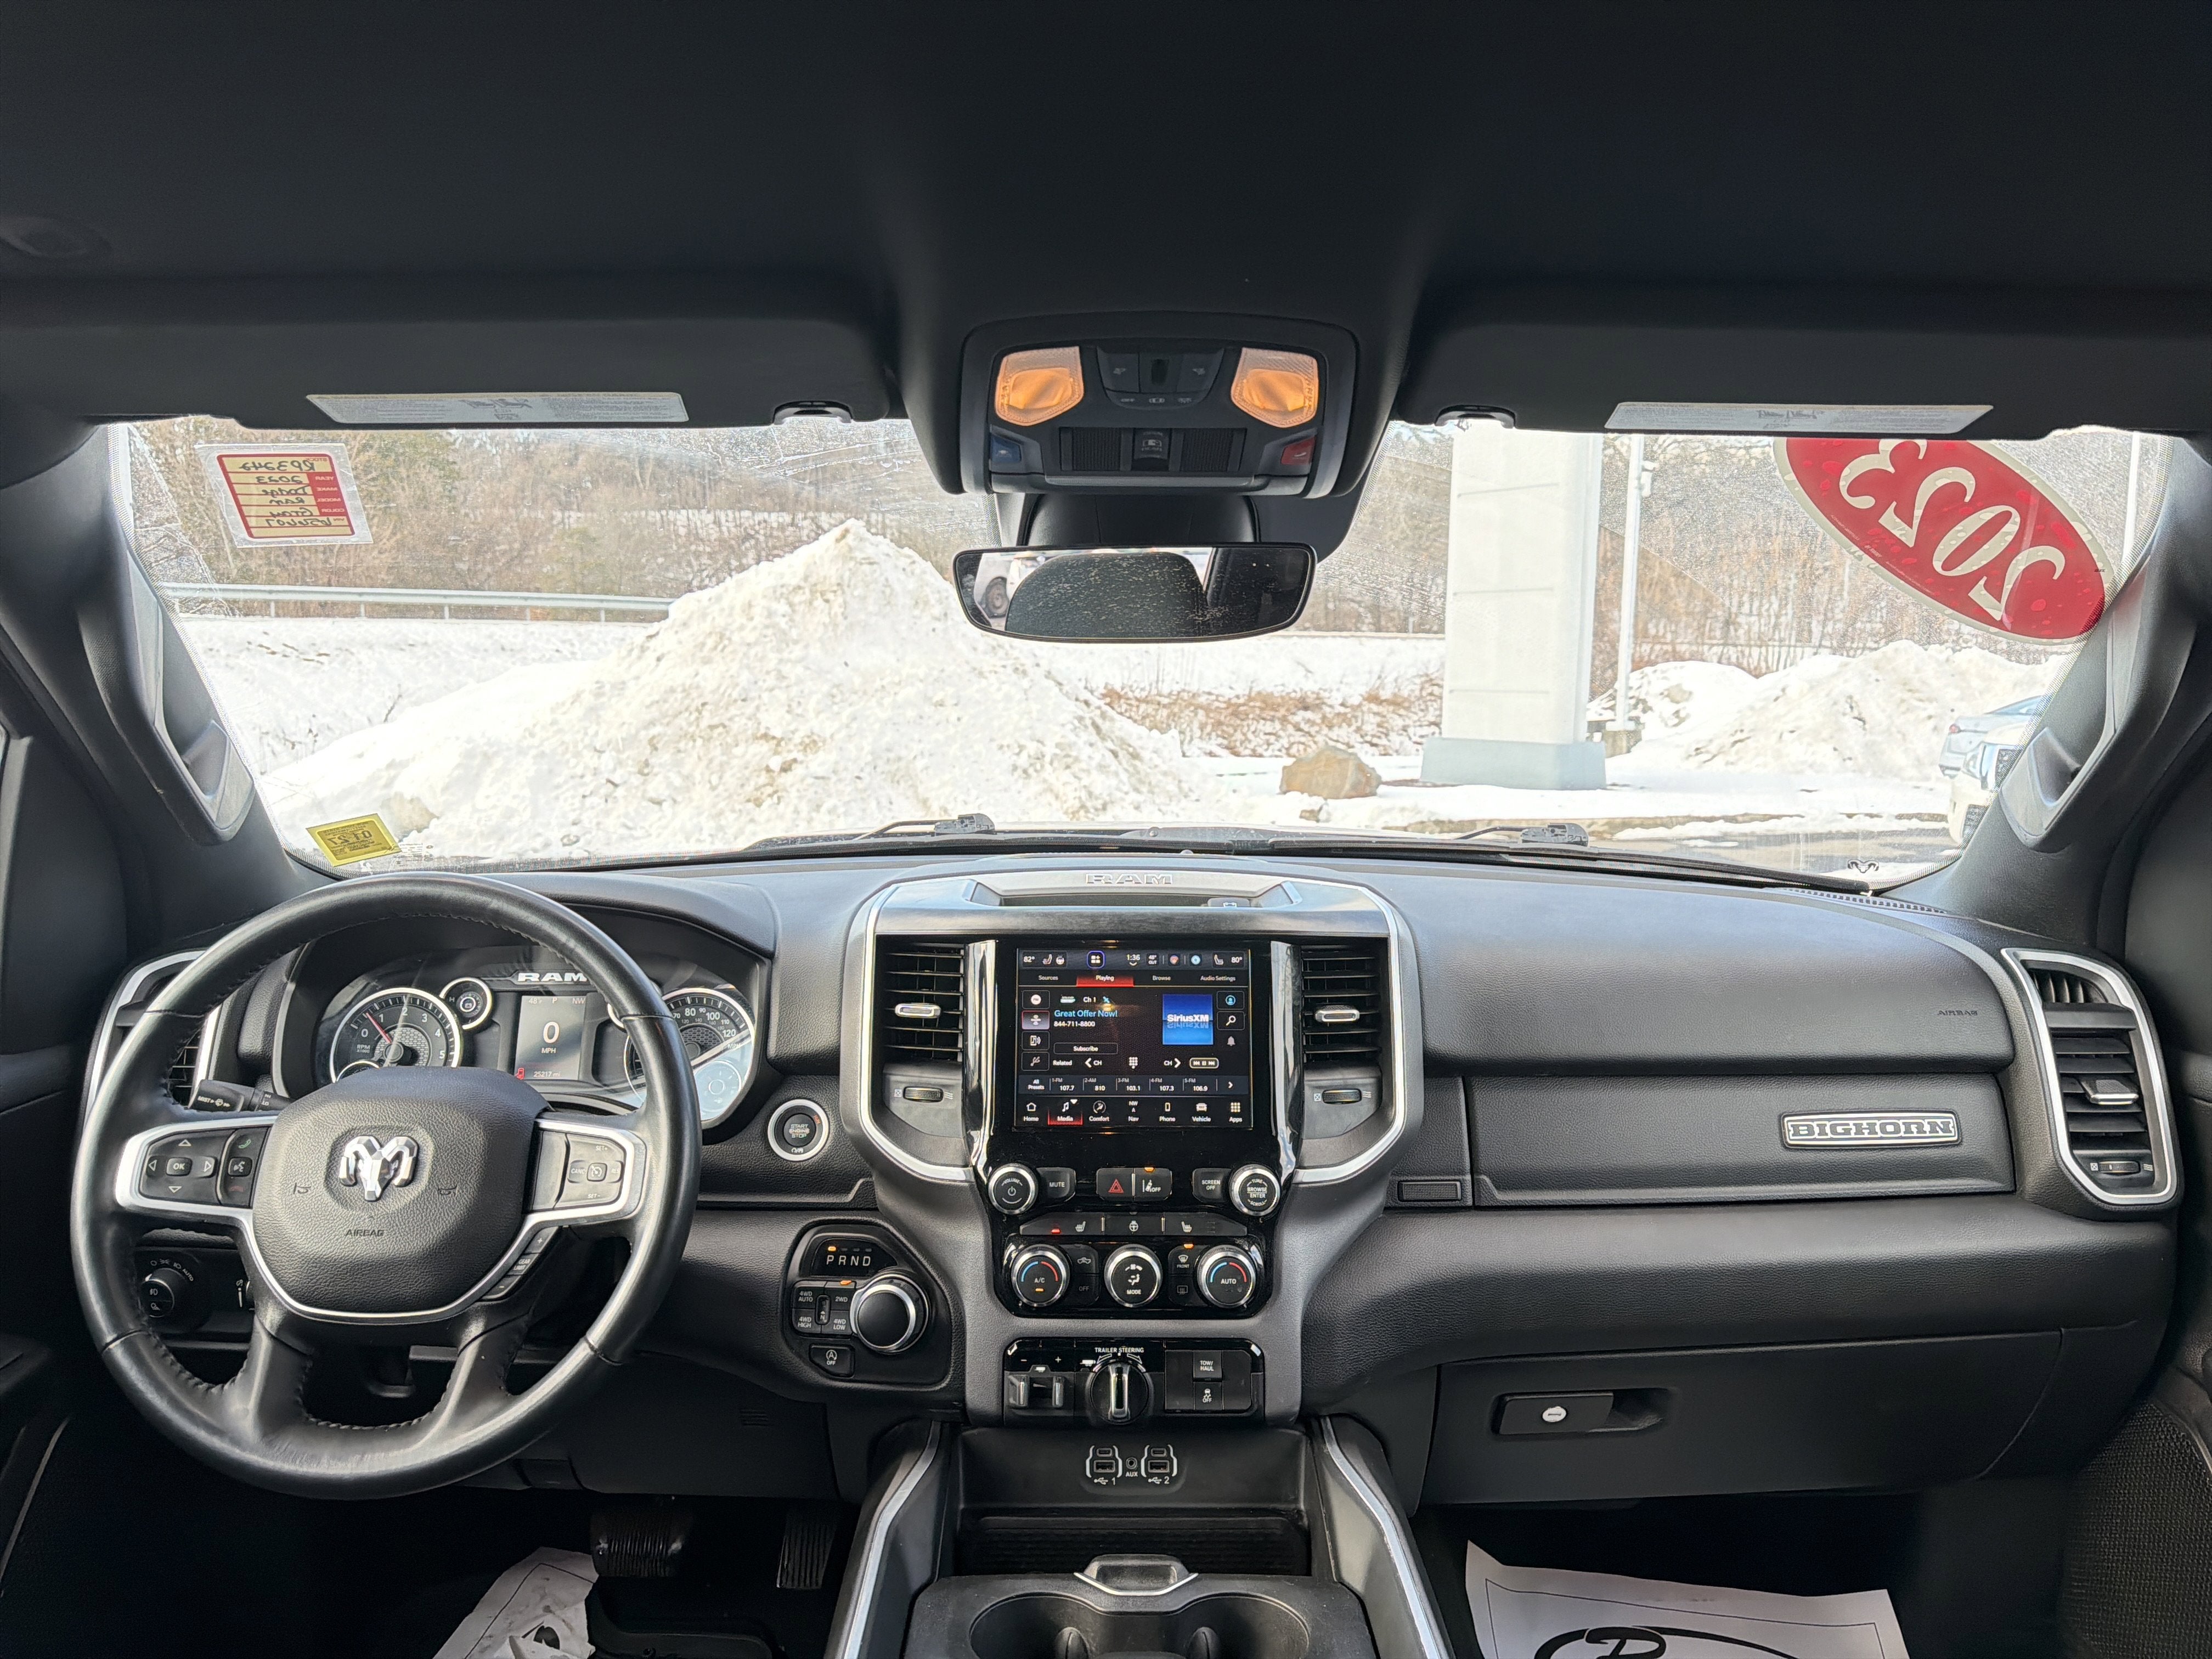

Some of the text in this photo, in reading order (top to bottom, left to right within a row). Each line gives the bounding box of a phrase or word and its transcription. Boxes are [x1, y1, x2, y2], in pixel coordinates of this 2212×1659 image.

[1086, 873, 1173, 885] RAM
[517, 973, 588, 982] RAM
[402, 1007, 408, 1015] 2
[685, 1008, 696, 1017] 80
[379, 1014, 384, 1023] 1
[421, 1013, 427, 1022] 3
[706, 1012, 720, 1020] 100
[361, 1029, 369, 1037] 0
[435, 1028, 441, 1037] 4
[543, 1022, 560, 1043] 0
[723, 1029, 736, 1037] 120
[439, 1050, 445, 1059] 5
[1789, 1119, 1955, 1139] BIGHORN
[345, 1228, 385, 1237] AIRBAG
[826, 1255, 871, 1266] P R N D
[183, 1268, 194, 1282] AUTO
